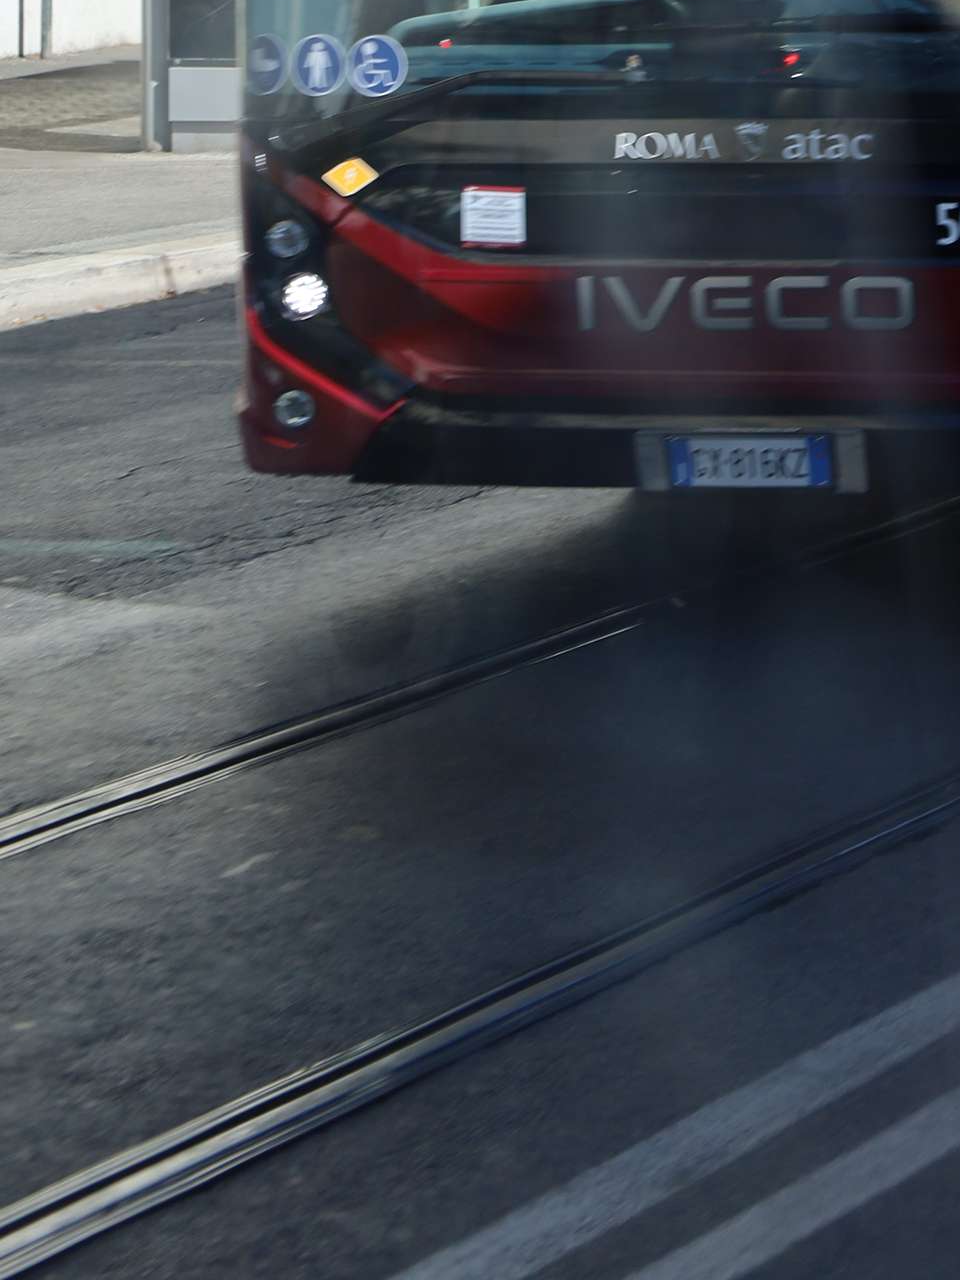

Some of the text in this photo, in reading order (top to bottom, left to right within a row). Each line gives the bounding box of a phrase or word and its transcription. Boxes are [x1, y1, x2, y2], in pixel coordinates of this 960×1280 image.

[612, 128, 876, 161] ROMA atac
[575, 275, 915, 332] IVECO
